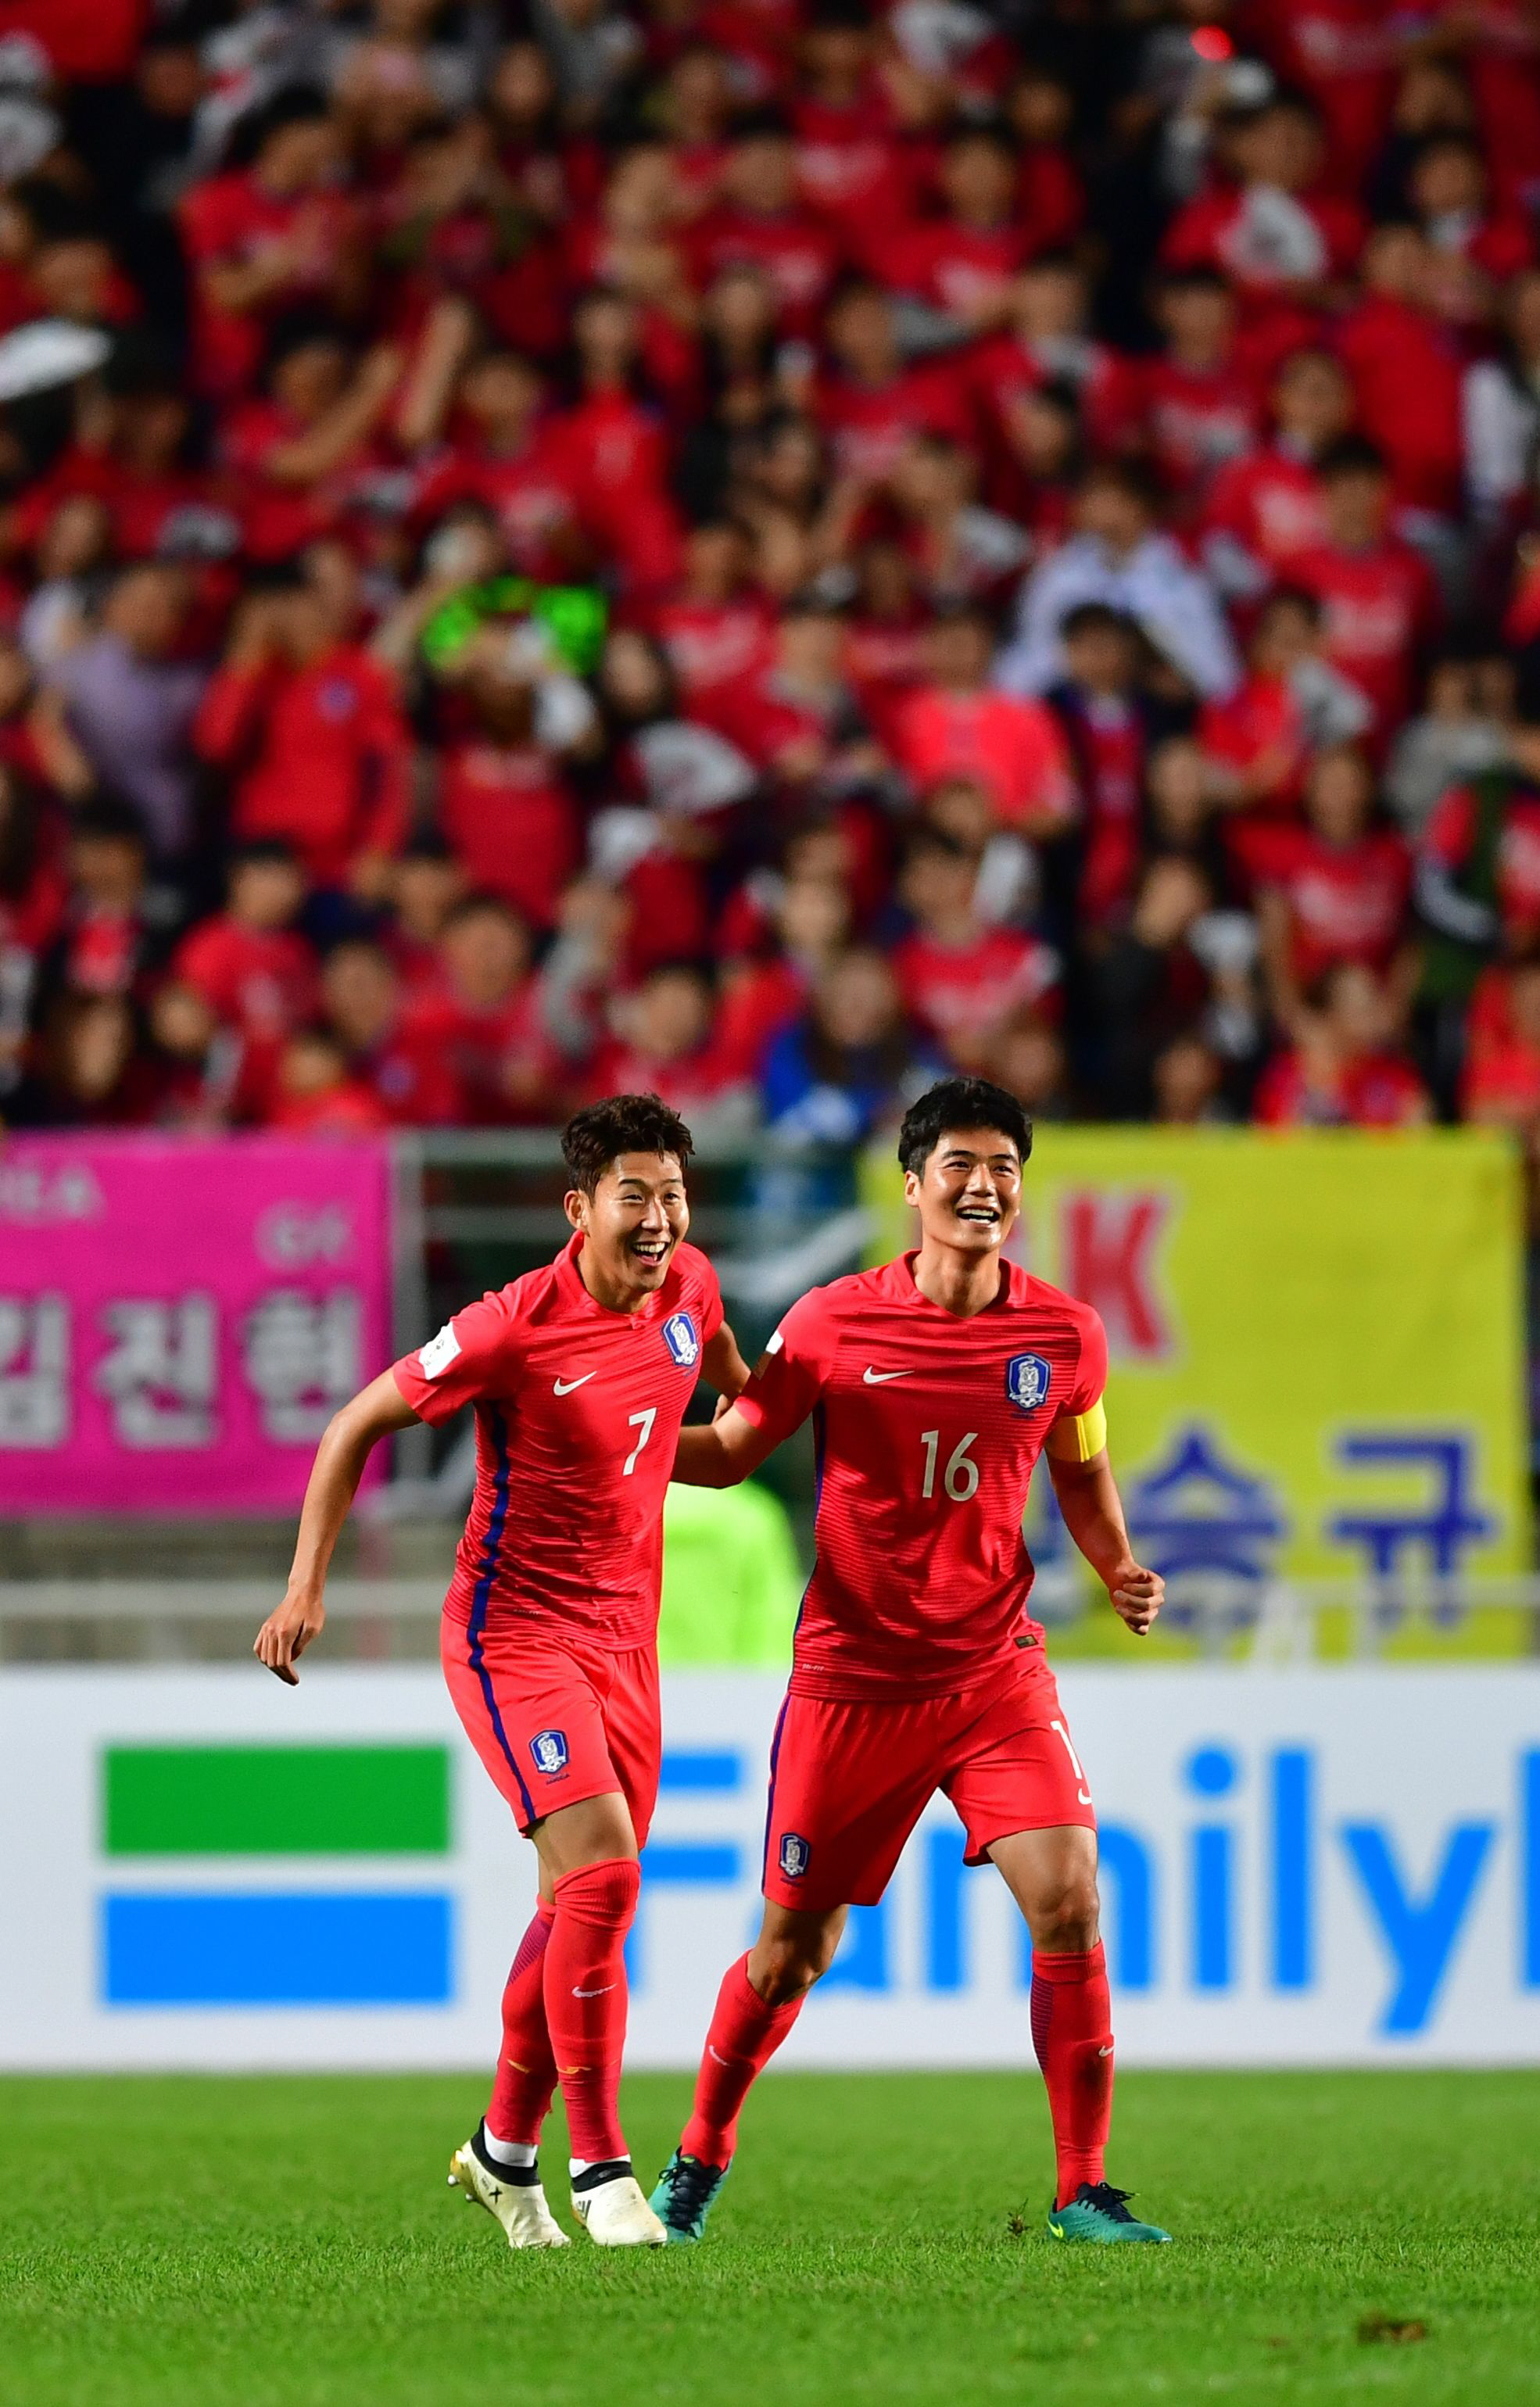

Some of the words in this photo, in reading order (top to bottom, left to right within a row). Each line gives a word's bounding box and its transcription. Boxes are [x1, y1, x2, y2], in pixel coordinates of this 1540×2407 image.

[622, 1406, 657, 1477] 7
[920, 1429, 980, 1503] 16
[1050, 1720, 1093, 1805] 1
